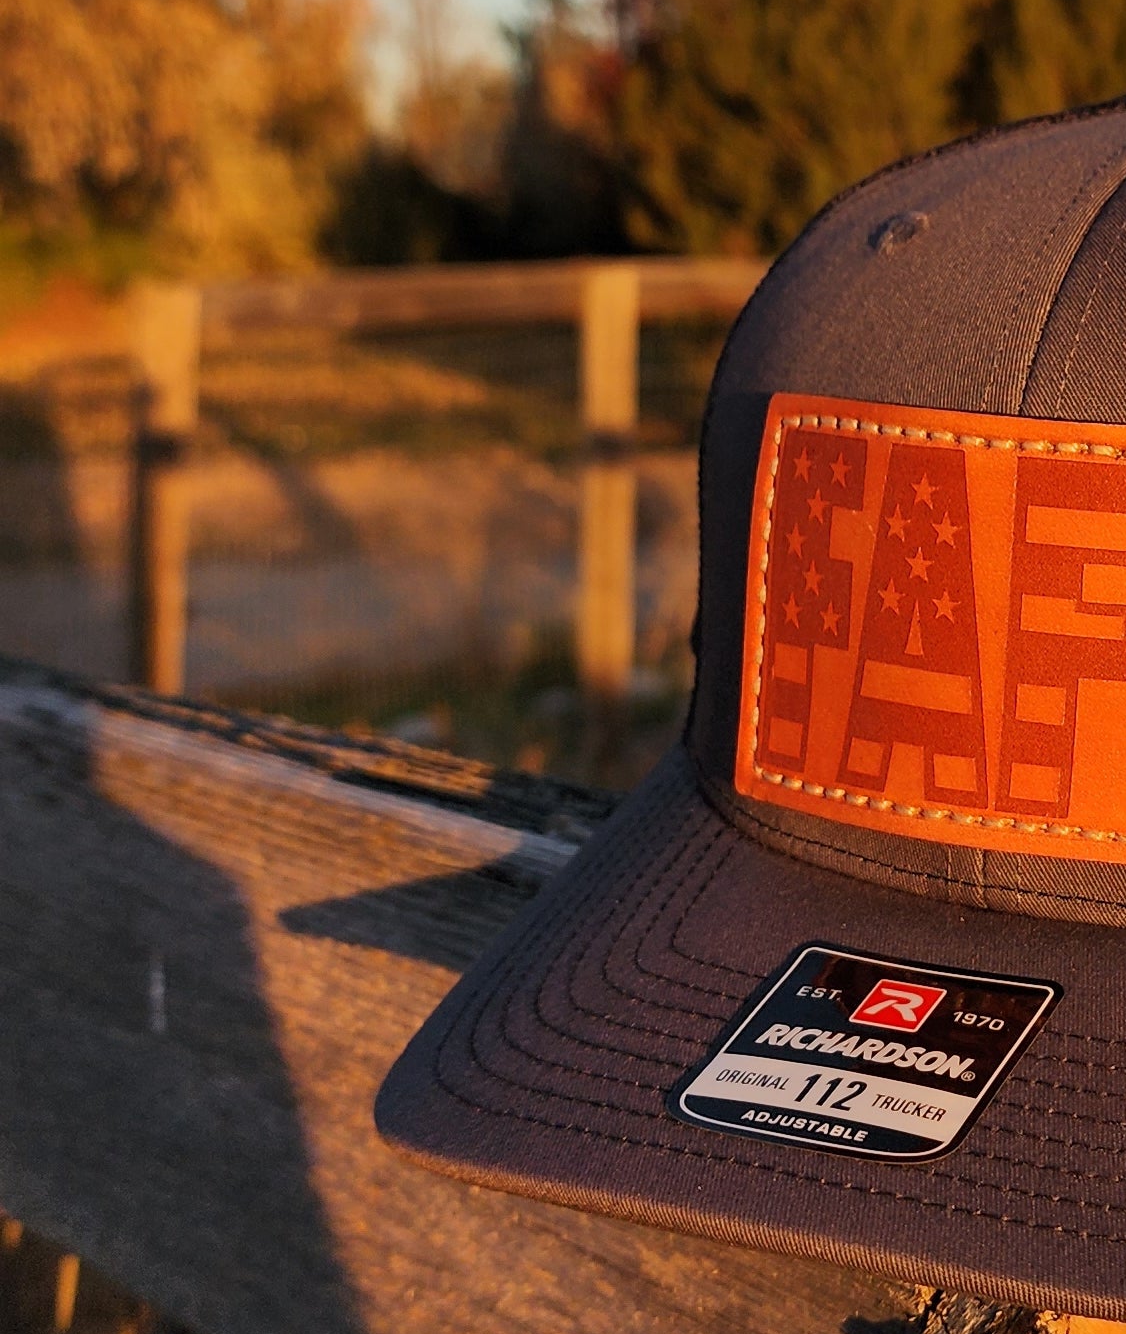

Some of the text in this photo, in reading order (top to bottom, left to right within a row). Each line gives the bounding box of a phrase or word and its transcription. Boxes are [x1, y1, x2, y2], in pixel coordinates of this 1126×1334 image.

[796, 985, 1005, 1031] EST. 1970
[863, 988, 928, 1023] R
[715, 1068, 947, 1123] ORIGINAL 112 TRUCKER
[741, 1109, 869, 1143] ADJUSTABLE
